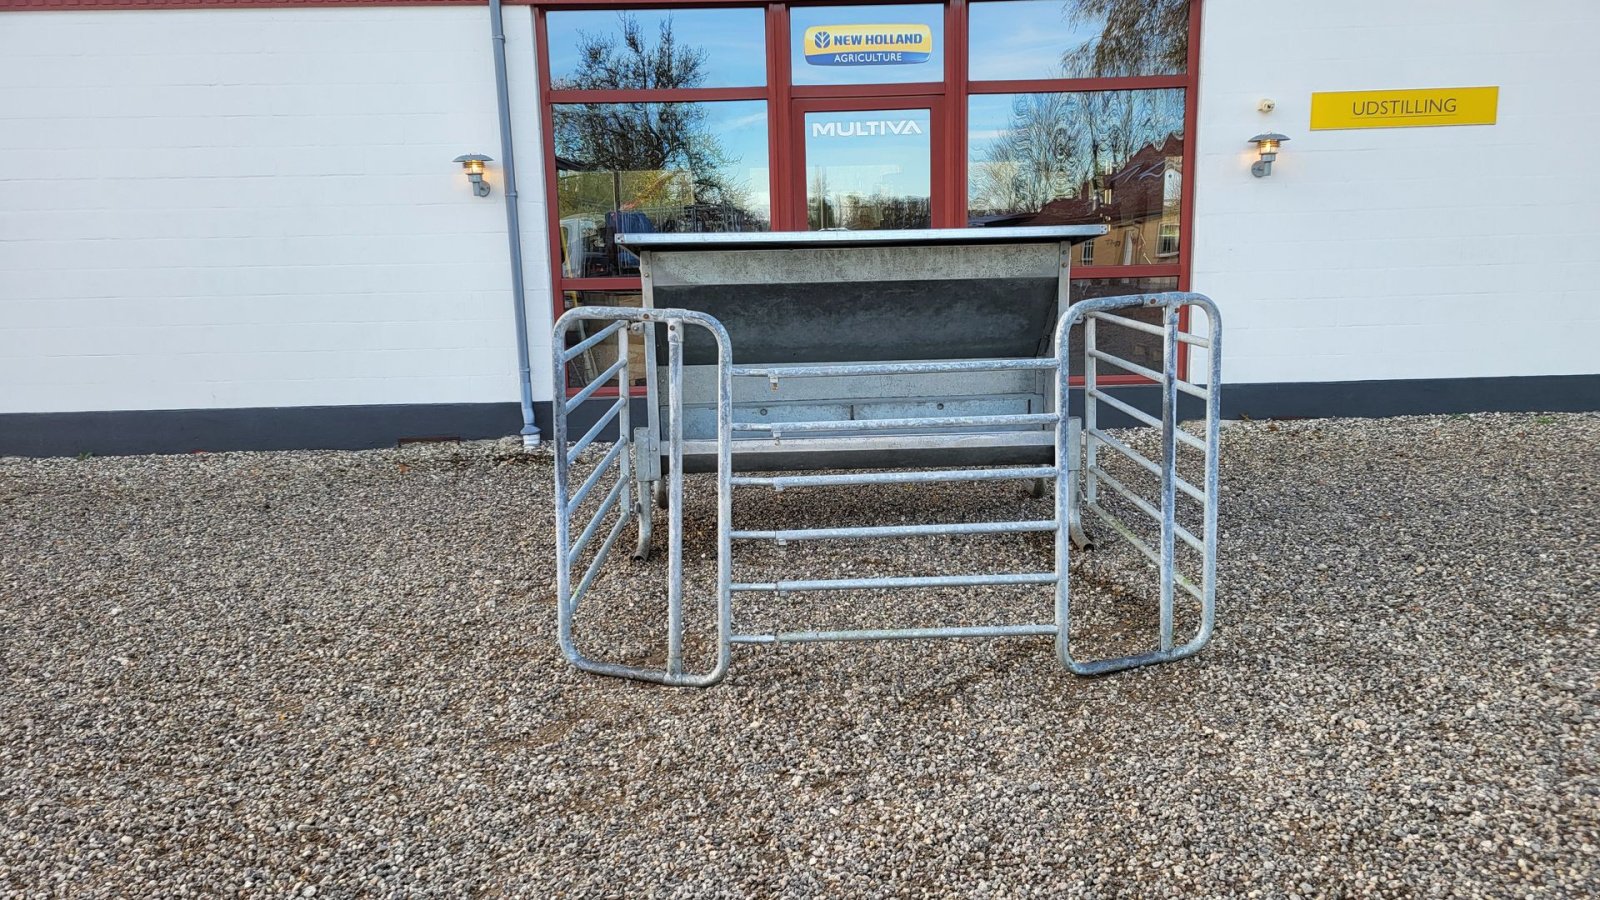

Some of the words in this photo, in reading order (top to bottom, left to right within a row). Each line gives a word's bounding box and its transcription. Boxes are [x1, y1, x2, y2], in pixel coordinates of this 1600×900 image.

[834, 35, 862, 46] NEW
[865, 34, 923, 45] HOLLAND
[834, 53, 902, 63] AGRICULTURE
[1352, 98, 1457, 116] UDSTILLING
[812, 120, 922, 137] MULTIVA
